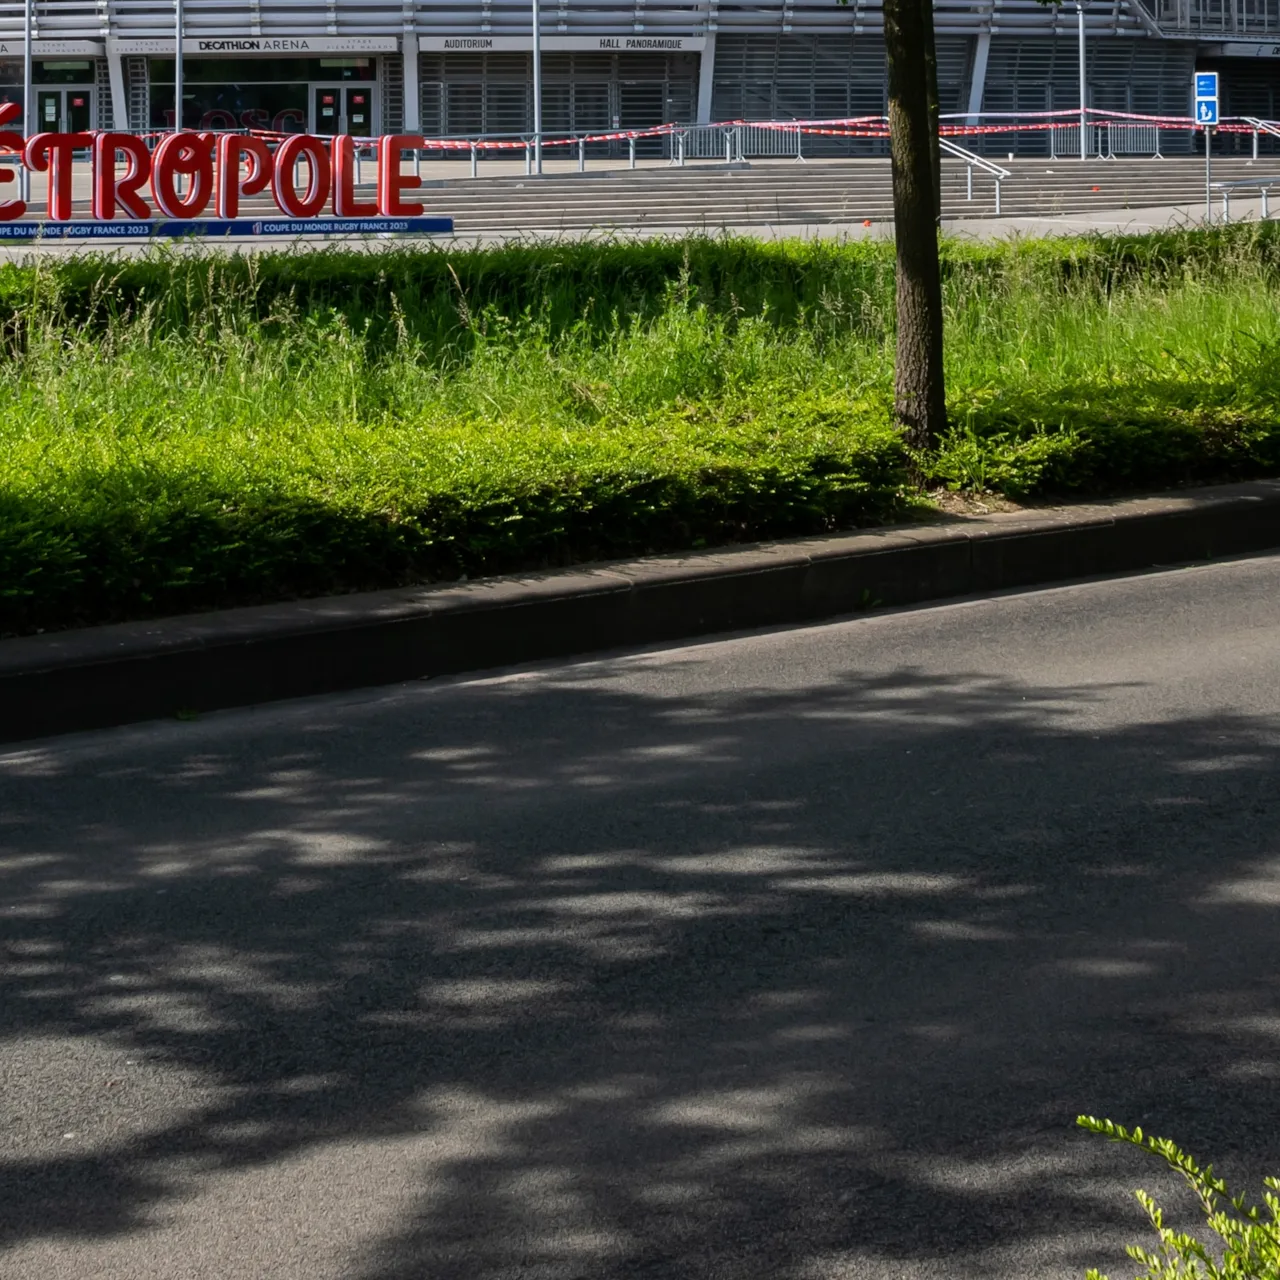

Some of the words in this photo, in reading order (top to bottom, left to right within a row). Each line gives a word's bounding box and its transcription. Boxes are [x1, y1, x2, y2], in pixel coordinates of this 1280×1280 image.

[199, 41, 260, 50] DECATHLON
[263, 40, 310, 50] ARENA
[444, 39, 493, 49] AUDITORIUM
[599, 38, 620, 48] HALL
[626, 39, 682, 49] PANORAMIQUE
[14, 227, 27, 235] DU
[28, 227, 61, 235] MONDE
[63, 227, 92, 235] RUGBY
[127, 226, 149, 234] 2023
[264, 224, 290, 232] COUPE
[304, 223, 333, 231] MONDE
[334, 223, 359, 231] RUGBY
[390, 222, 408, 230] 2023
